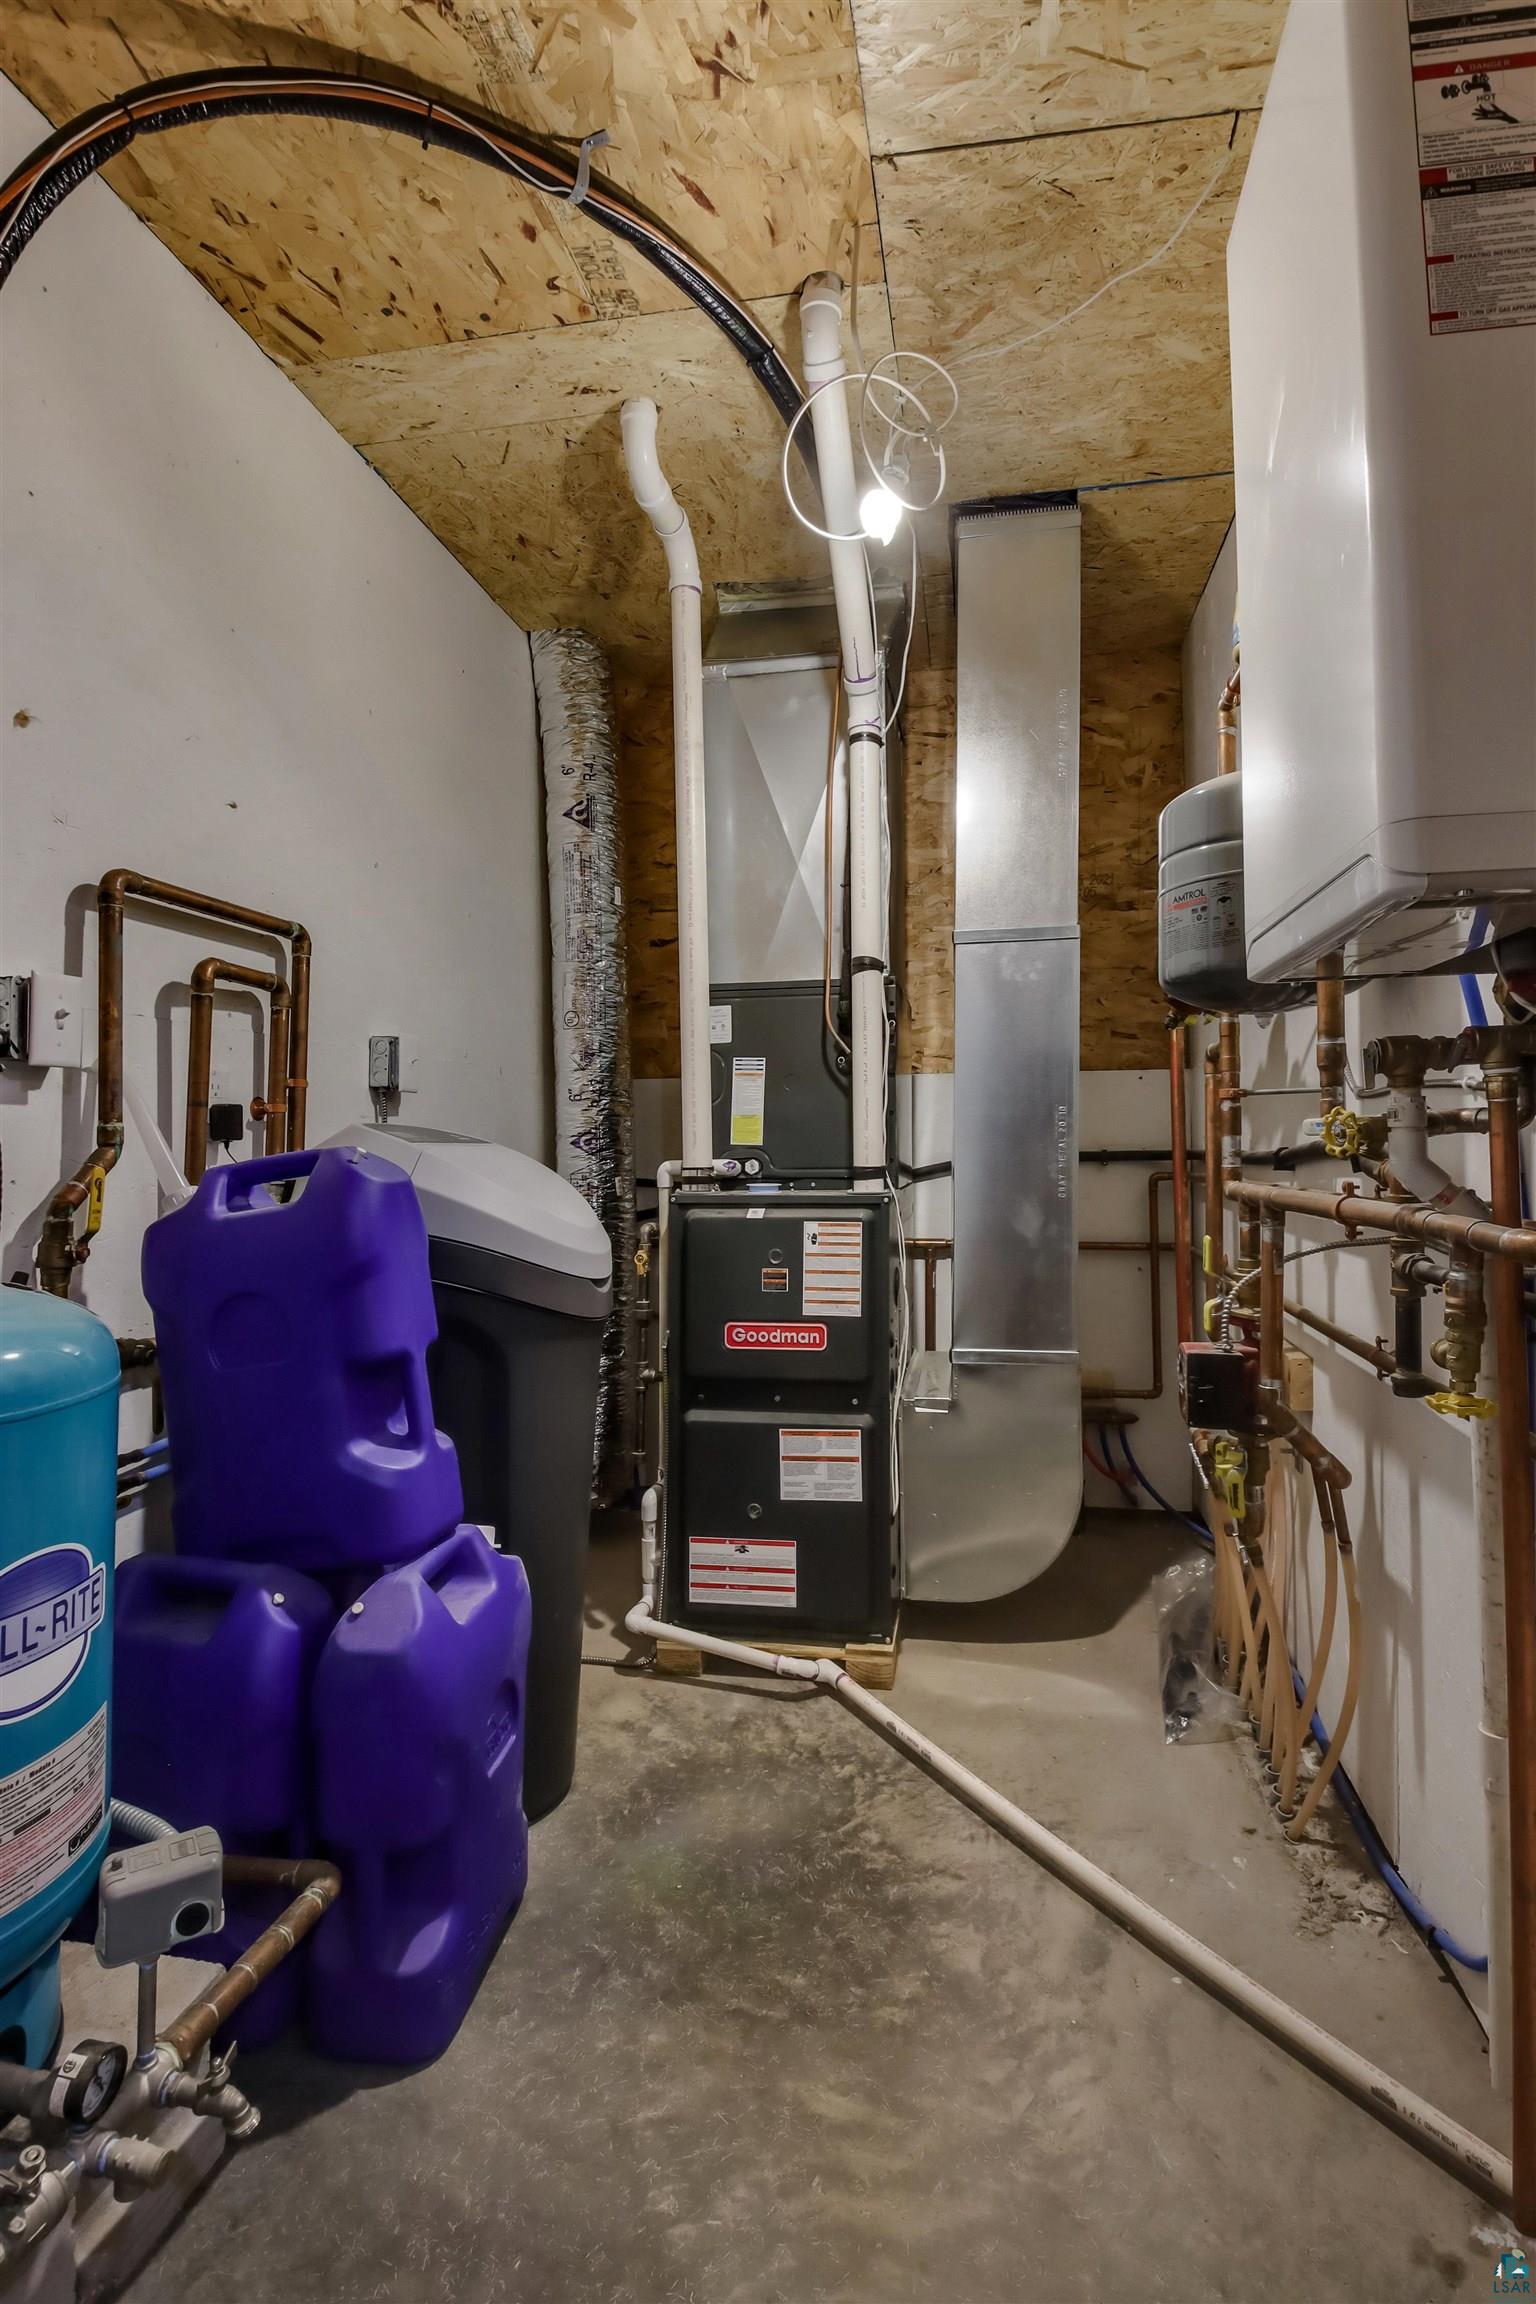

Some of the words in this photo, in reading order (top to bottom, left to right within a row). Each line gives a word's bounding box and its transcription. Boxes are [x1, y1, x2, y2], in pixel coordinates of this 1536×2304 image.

[1469, 59, 1511, 71] DANGER
[1476, 93, 1496, 103] HOT
[1448, 166, 1463, 174] FOR
[1464, 163, 1483, 173] YOUR
[1485, 160, 1511, 170] SAFETY
[1512, 158, 1532, 167] READ
[1456, 170, 1483, 179] BEFORE
[1486, 166, 1526, 175] OPERATING
[1456, 250, 1491, 260] OPERATING
[1173, 889, 1206, 904] AMTROL
[731, 1327, 820, 1345] Goodman
